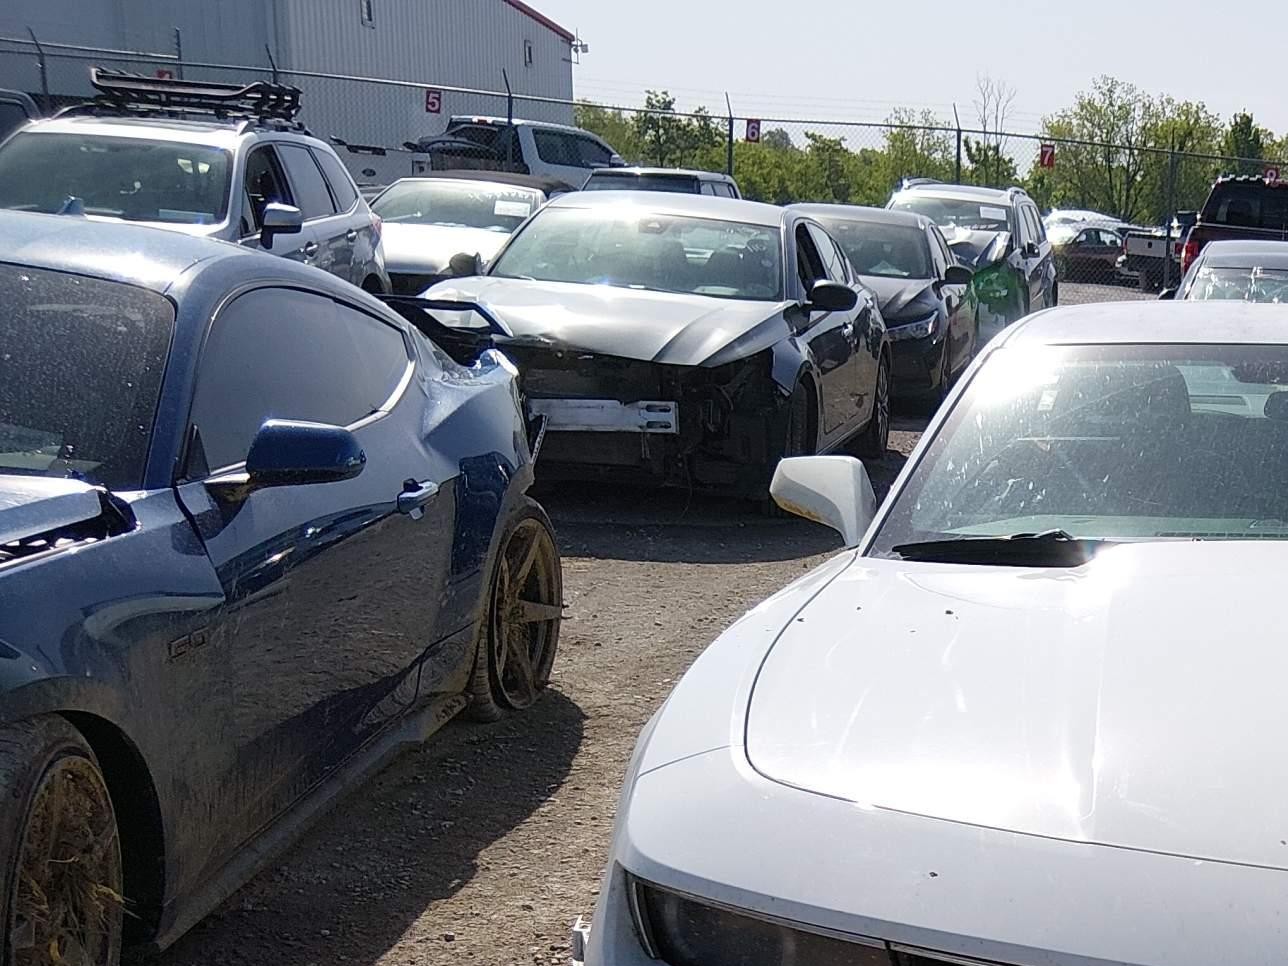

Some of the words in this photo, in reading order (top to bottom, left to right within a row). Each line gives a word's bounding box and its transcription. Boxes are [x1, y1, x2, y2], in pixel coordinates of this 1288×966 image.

[427, 92, 440, 111] 5
[747, 122, 759, 141] 6
[1042, 146, 1053, 165] 7
